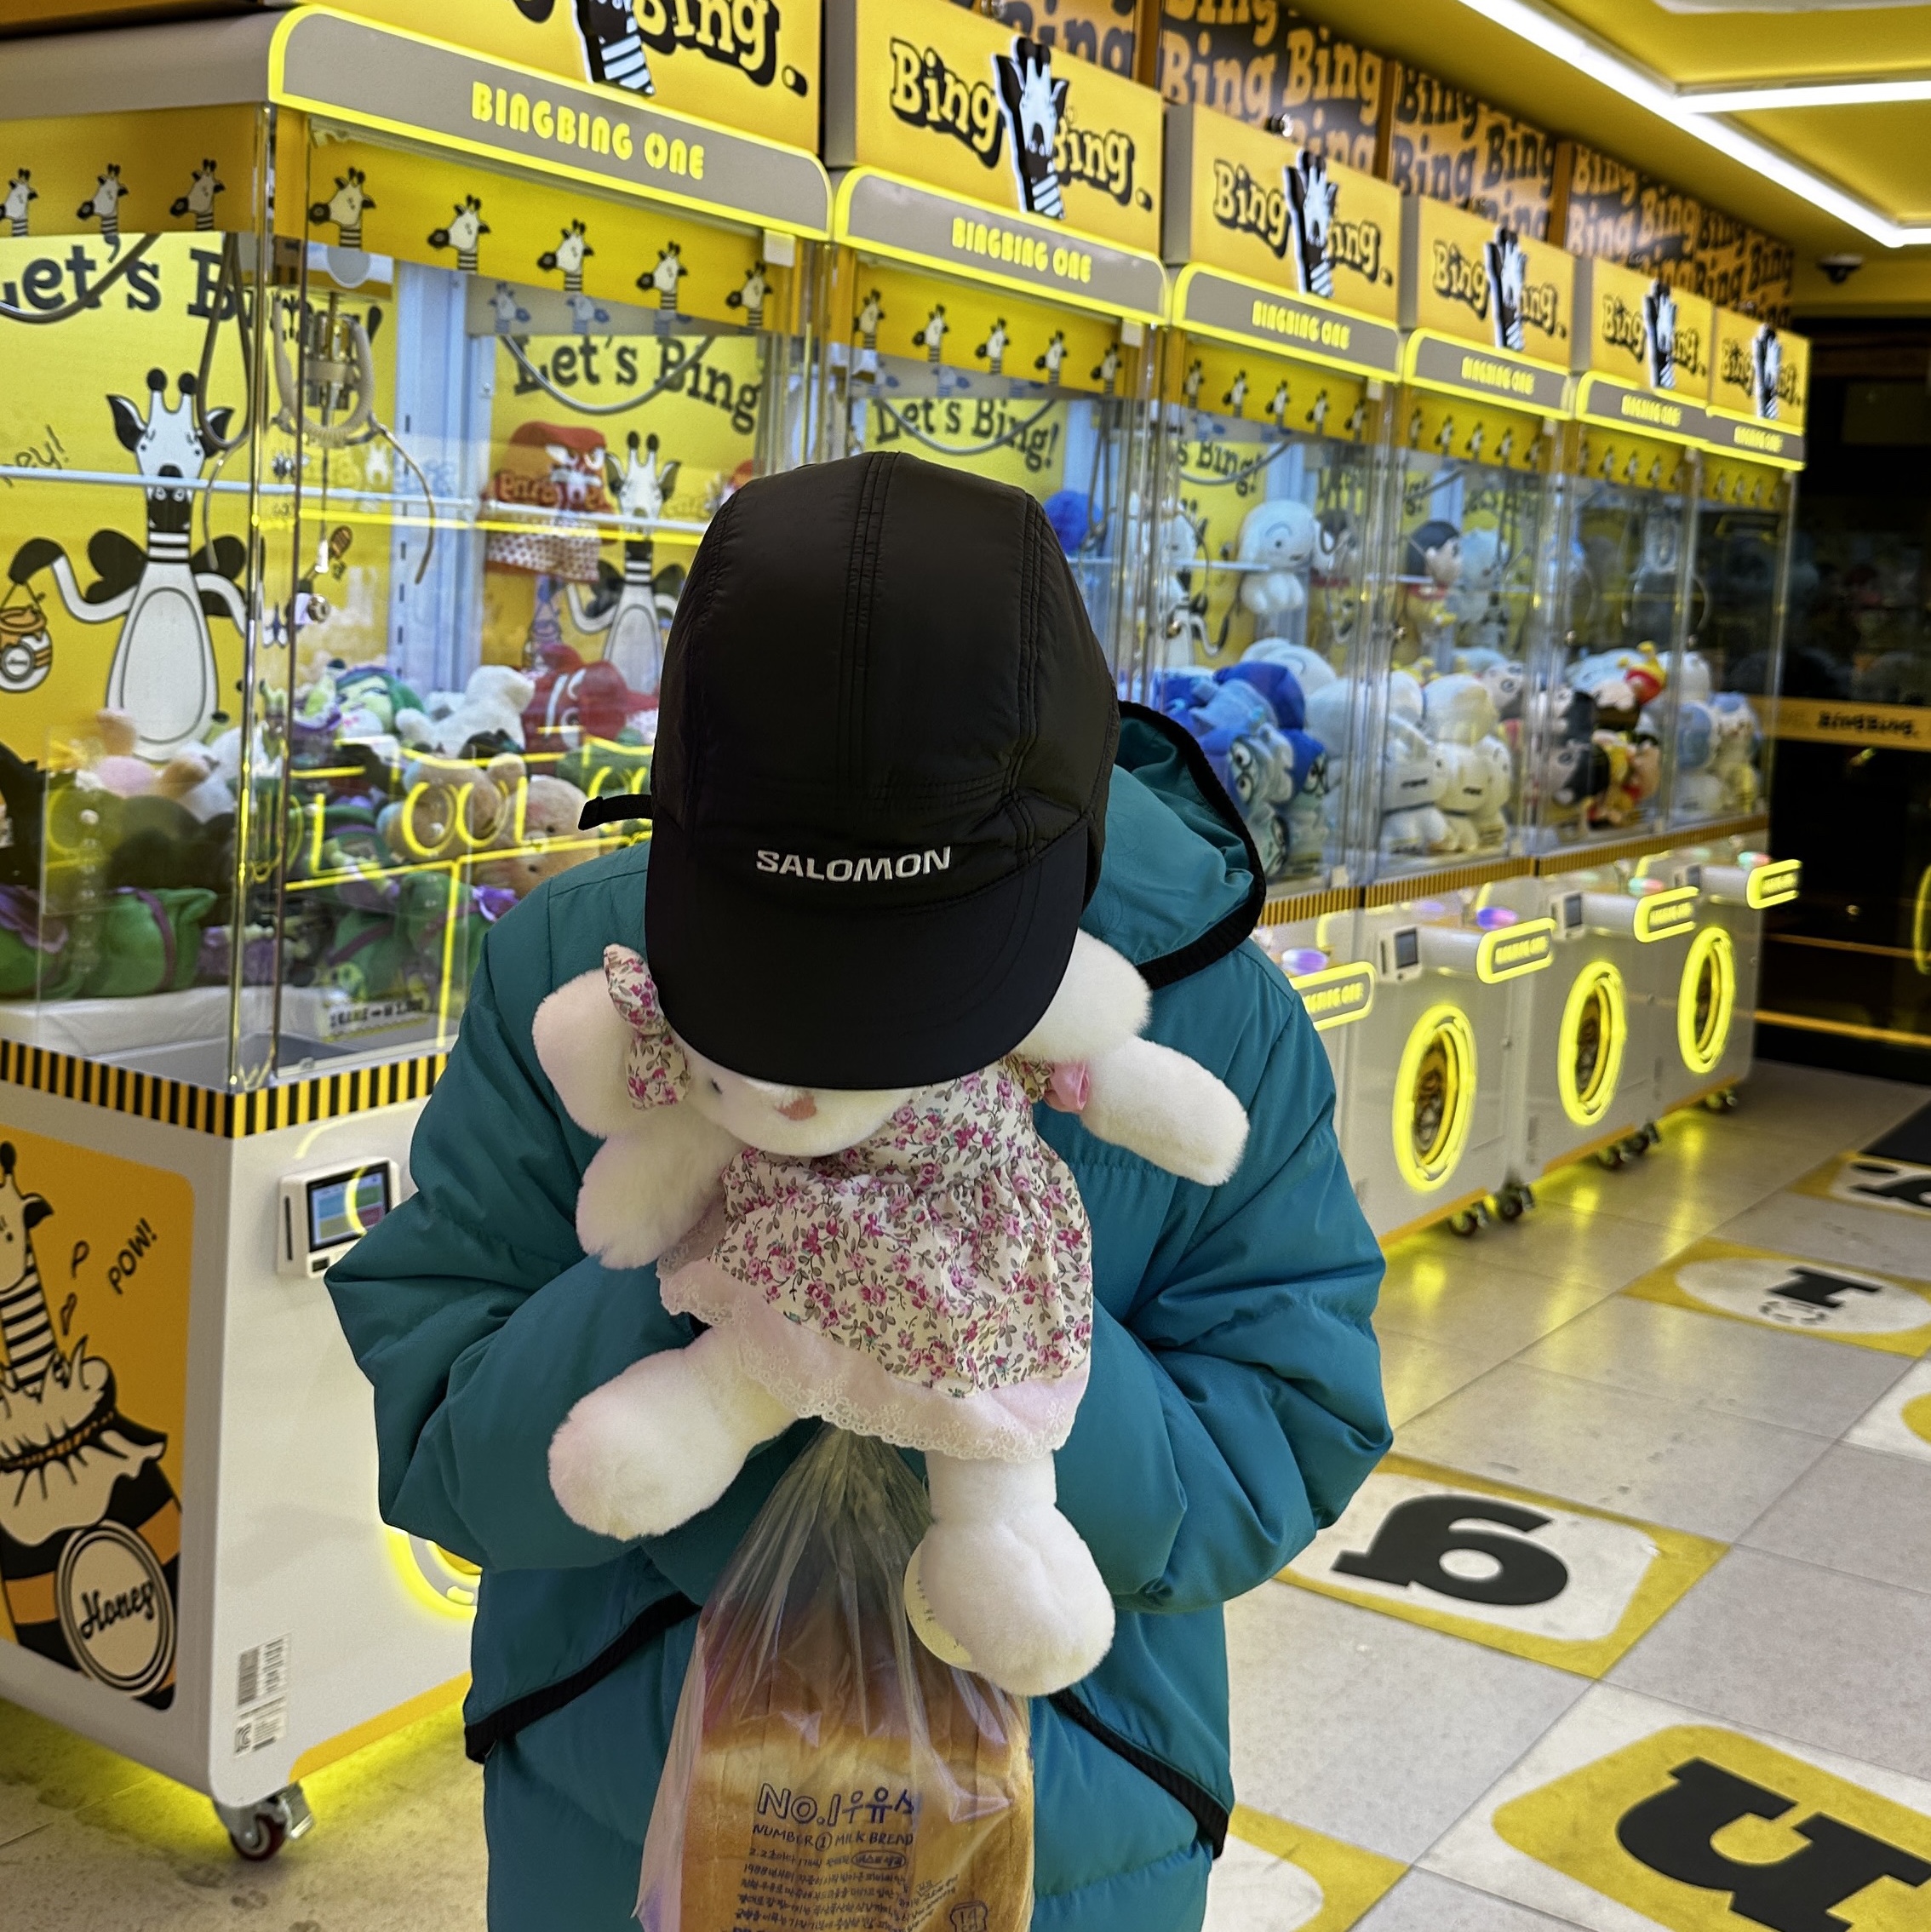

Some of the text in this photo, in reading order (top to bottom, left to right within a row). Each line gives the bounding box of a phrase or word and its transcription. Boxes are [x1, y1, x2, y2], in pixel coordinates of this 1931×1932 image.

[1160, 27, 1383, 129] Bing Bing
[472, 82, 704, 180] BINGBING ONE
[891, 37, 1153, 211] Bing ing.
[1214, 159, 1291, 259] Bing
[0, 234, 161, 312] et's
[951, 216, 1092, 284] BINGBING ONE
[1433, 240, 1490, 322] Bing
[756, 846, 951, 882] SALOMON
[108, 1218, 158, 1296] POW!
[80, 1578, 153, 1640] Honey
[753, 1824, 815, 1847] NUMBER
[868, 1831, 914, 1846] BREAD
[757, 1782, 842, 1827] No.1
